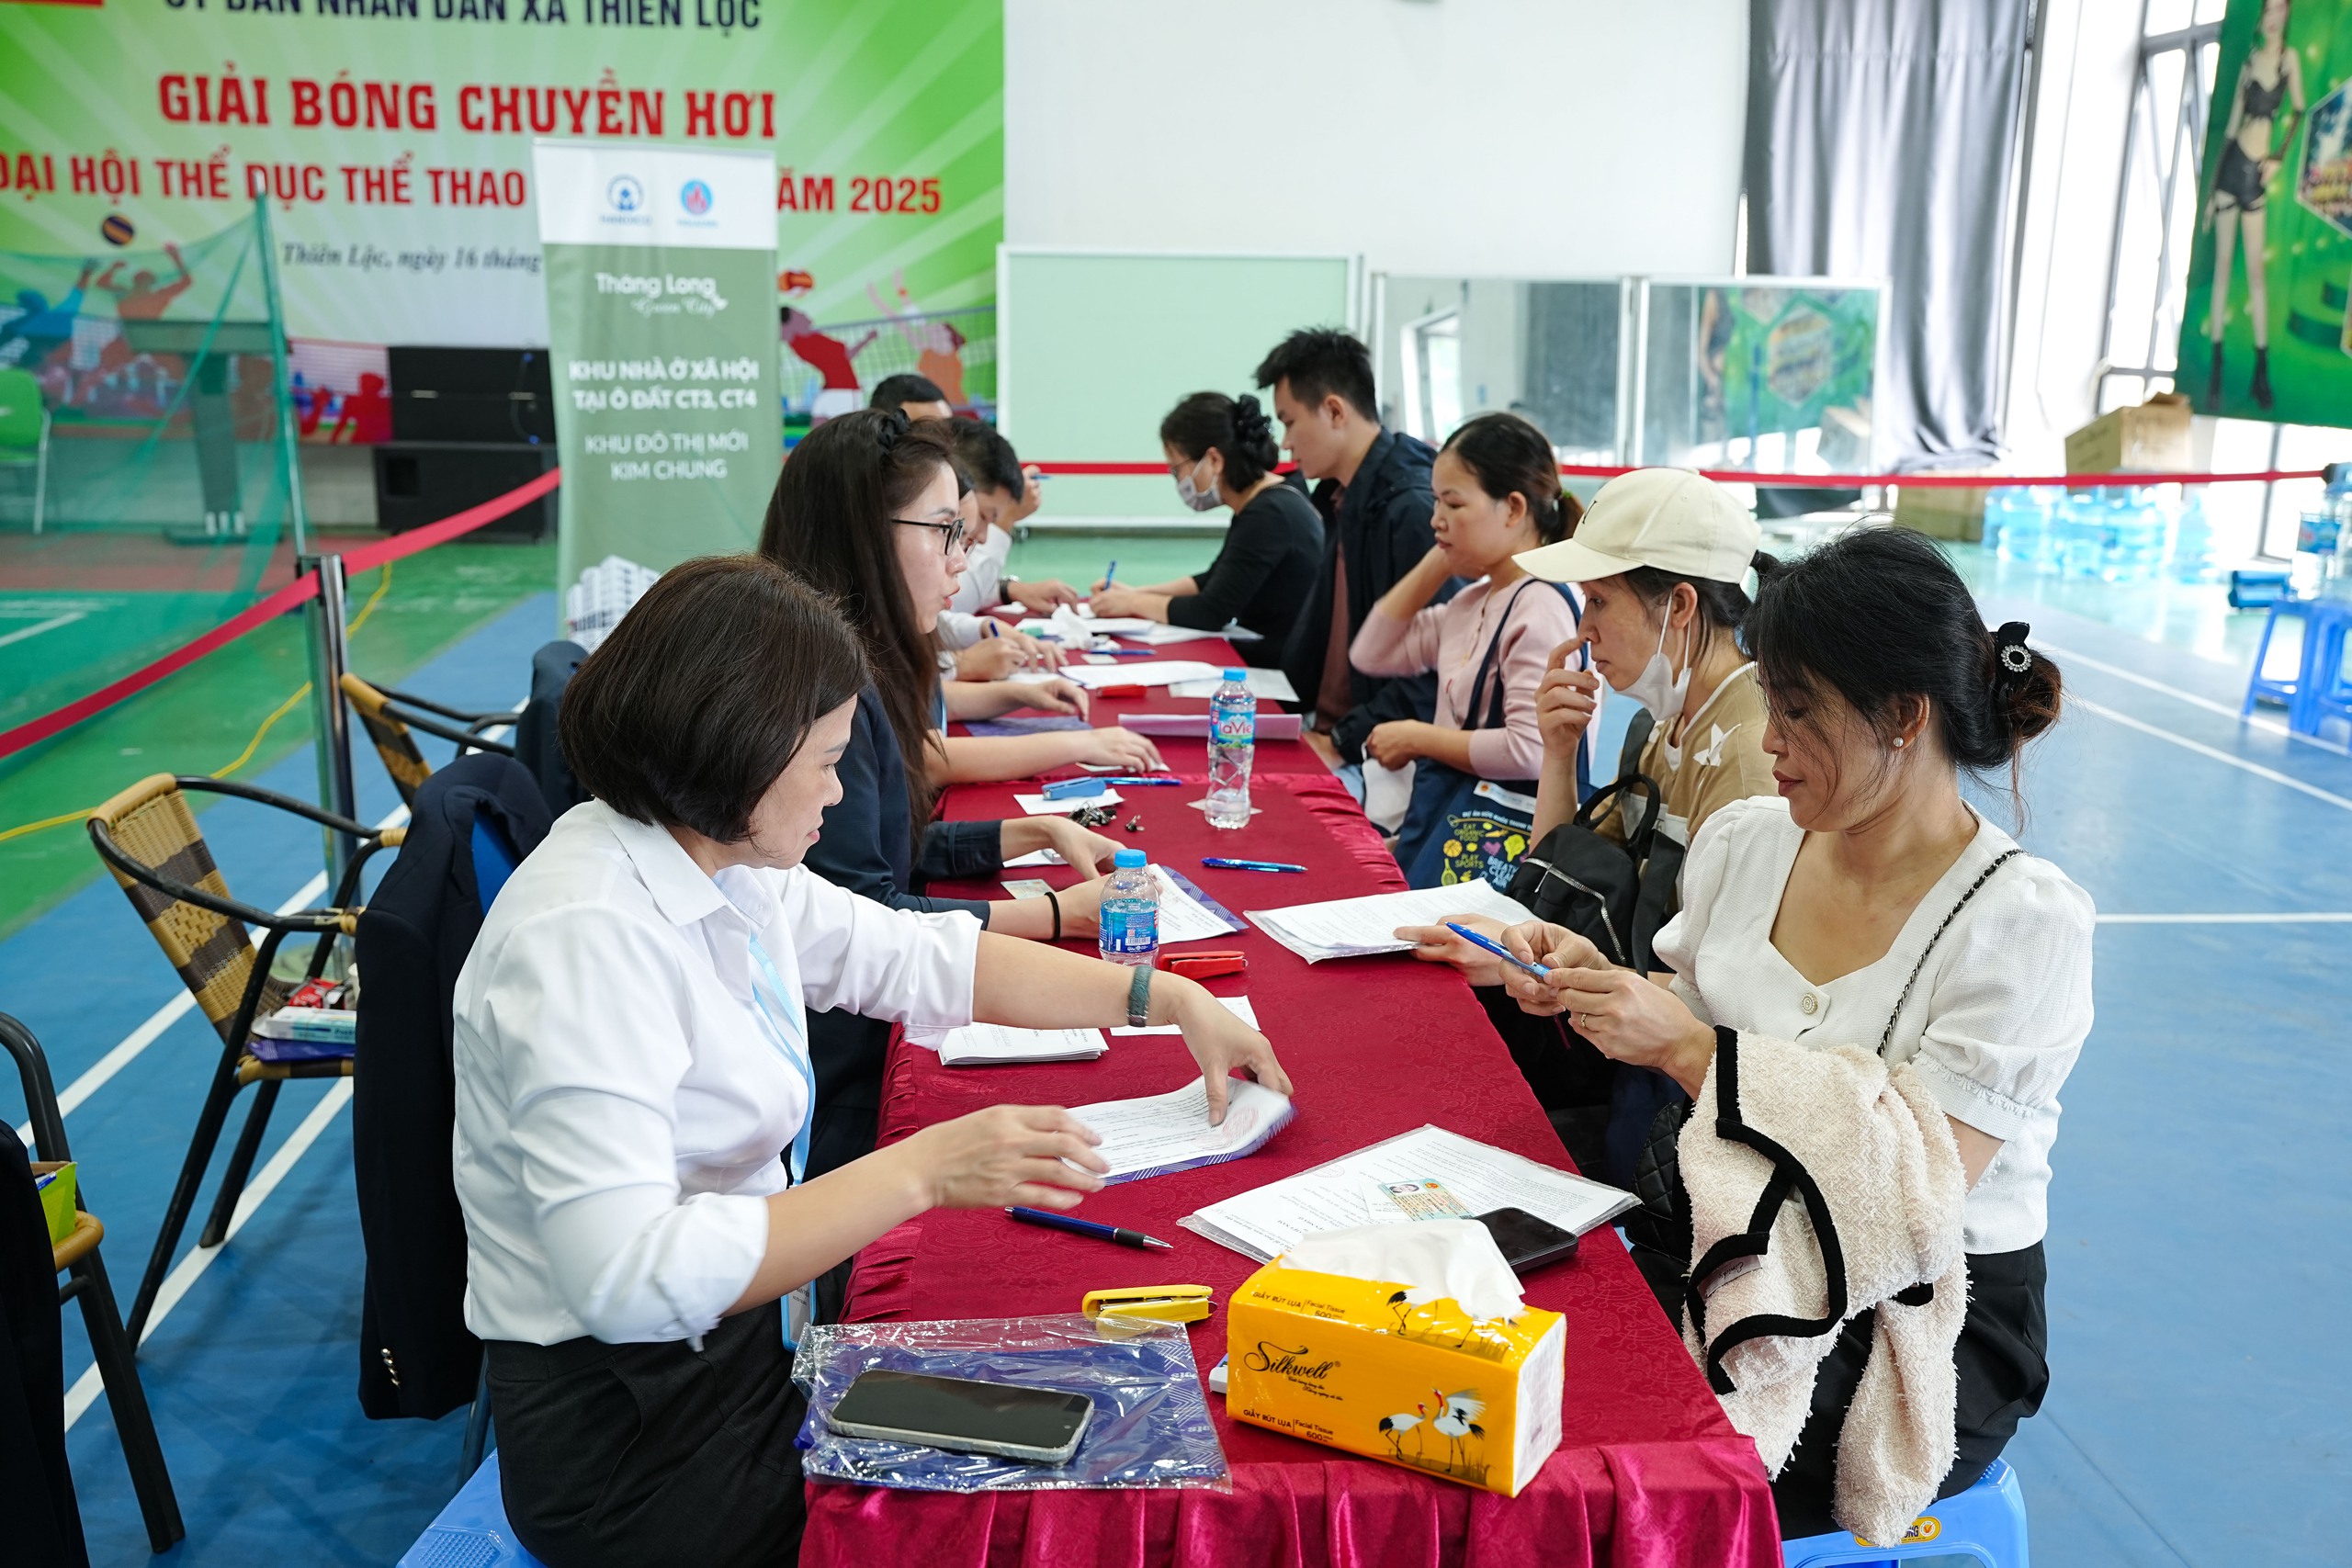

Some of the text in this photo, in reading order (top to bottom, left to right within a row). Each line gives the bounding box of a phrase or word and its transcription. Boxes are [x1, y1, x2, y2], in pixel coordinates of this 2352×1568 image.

[158, 61, 777, 138] GIẢI BÓNG CHUYỀN HƠI
[70, 147, 141, 205] HỘI
[154, 144, 230, 199] THỂ
[245, 164, 324, 210] DỤC
[341, 151, 413, 205] THỂ
[427, 169, 526, 207] THAO
[776, 167, 834, 213] ĂM
[849, 177, 940, 213] 2025
[282, 242, 542, 275] Thiên Lộc, ngày 16 tháng
[665, 273, 717, 299] Long
[569, 356, 760, 383] KHU NHÀ Ở XÃ HỘI
[572, 389, 607, 413] TẠI
[609, 386, 628, 410] Ô
[630, 385, 673, 410] ĐẤT
[719, 389, 757, 409] CT4
[585, 428, 749, 456] KHU ĐÔ THỊ MỚI
[611, 458, 728, 480] KIM CHUNG
[1219, 720, 1252, 734] laVie
[1455, 859, 1485, 869] SPORTS
[1306, 1300, 1346, 1314] Facial Tissue
[1243, 1341, 1333, 1379] Silkwell
[1261, 1415, 1276, 1423] RÚT
[1277, 1418, 1292, 1427] LỤA
[1295, 1419, 1334, 1435] Facial Tissue
[1306, 1430, 1323, 1441] 600
[1904, 1525, 1919, 1539] NG
